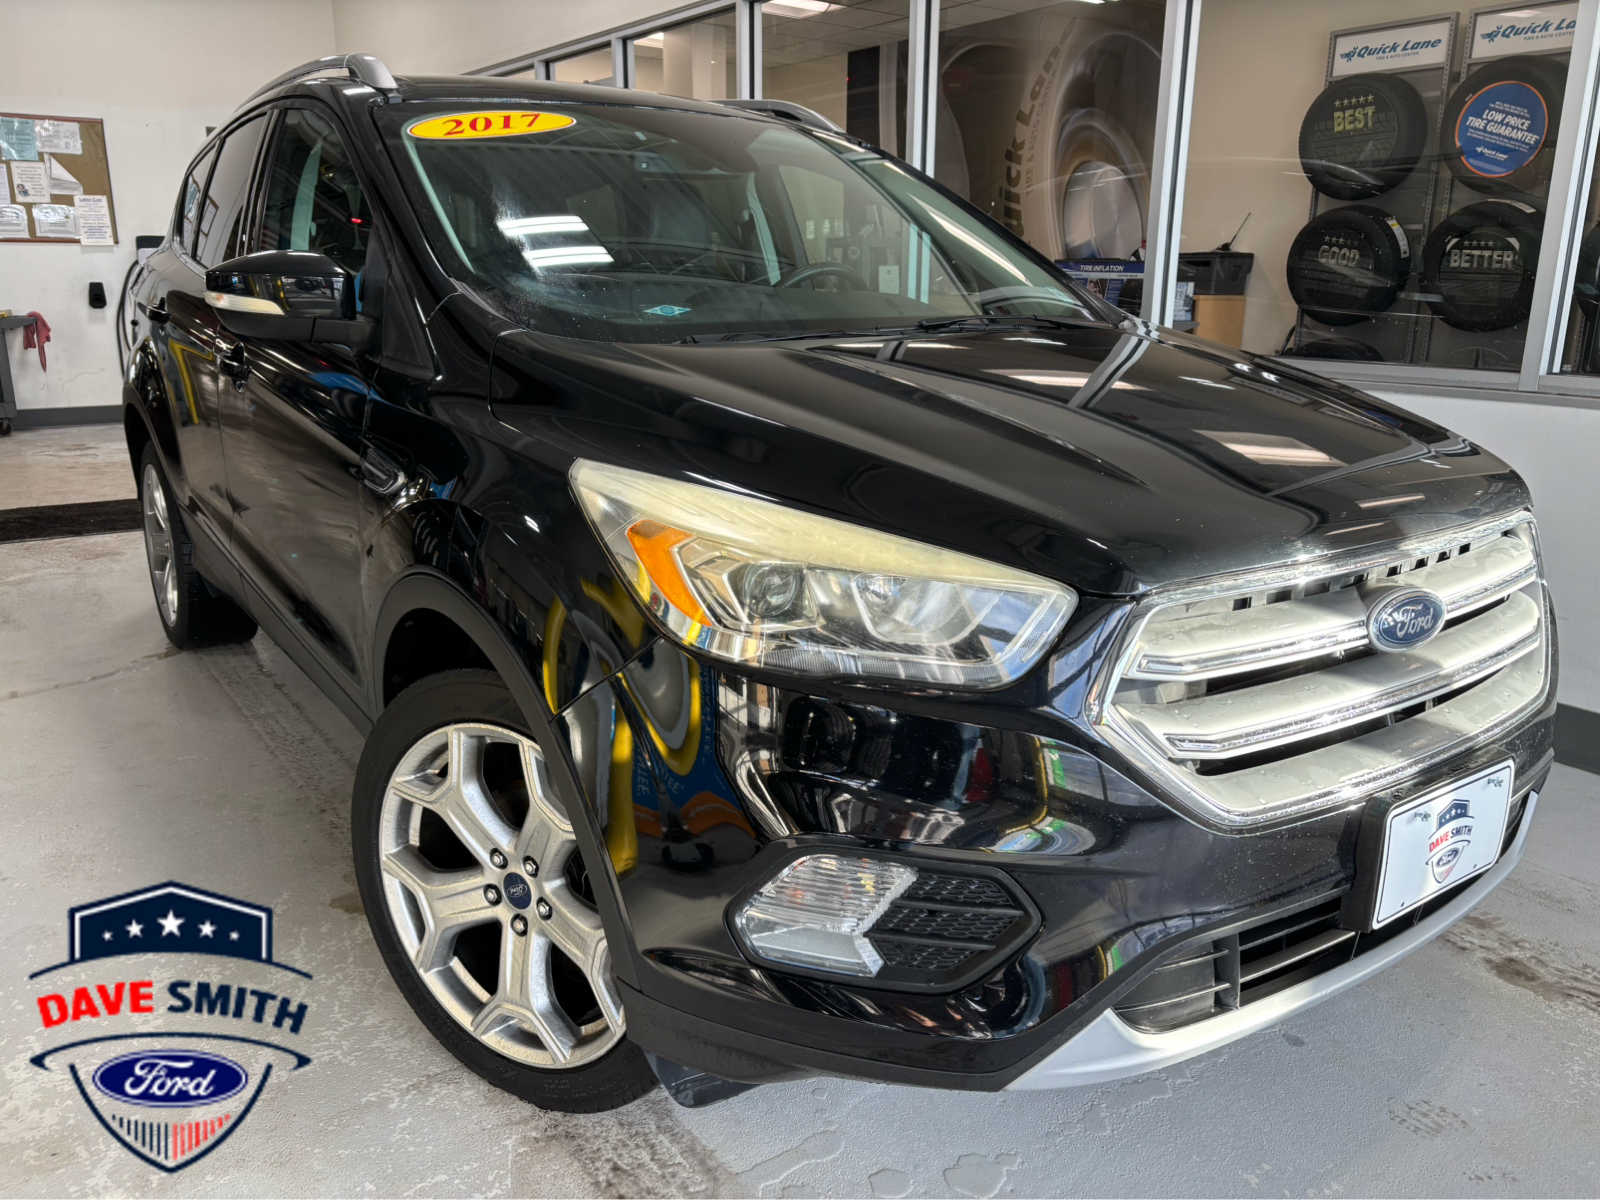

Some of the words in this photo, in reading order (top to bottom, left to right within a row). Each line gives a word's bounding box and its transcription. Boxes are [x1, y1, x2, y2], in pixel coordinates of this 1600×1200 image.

[1500, 20, 1553, 38] Quick
[1555, 18, 1577, 31] La
[1357, 42, 1400, 58] Quick
[1400, 39, 1442, 51] Lane
[441, 113, 540, 136] 2017
[1333, 106, 1376, 133] BEST
[1466, 116, 1487, 129] TIRE
[1486, 122, 1540, 144] GUARANTEE
[1482, 109, 1505, 122] LOW
[1503, 115, 1531, 130] PRICE
[1003, 137, 1026, 238] uick
[1319, 245, 1361, 266] GOOD
[1448, 249, 1514, 270] BETTER
[1395, 603, 1434, 638] Ford
[1429, 831, 1450, 853] DAVE
[1450, 825, 1473, 839] SMITH
